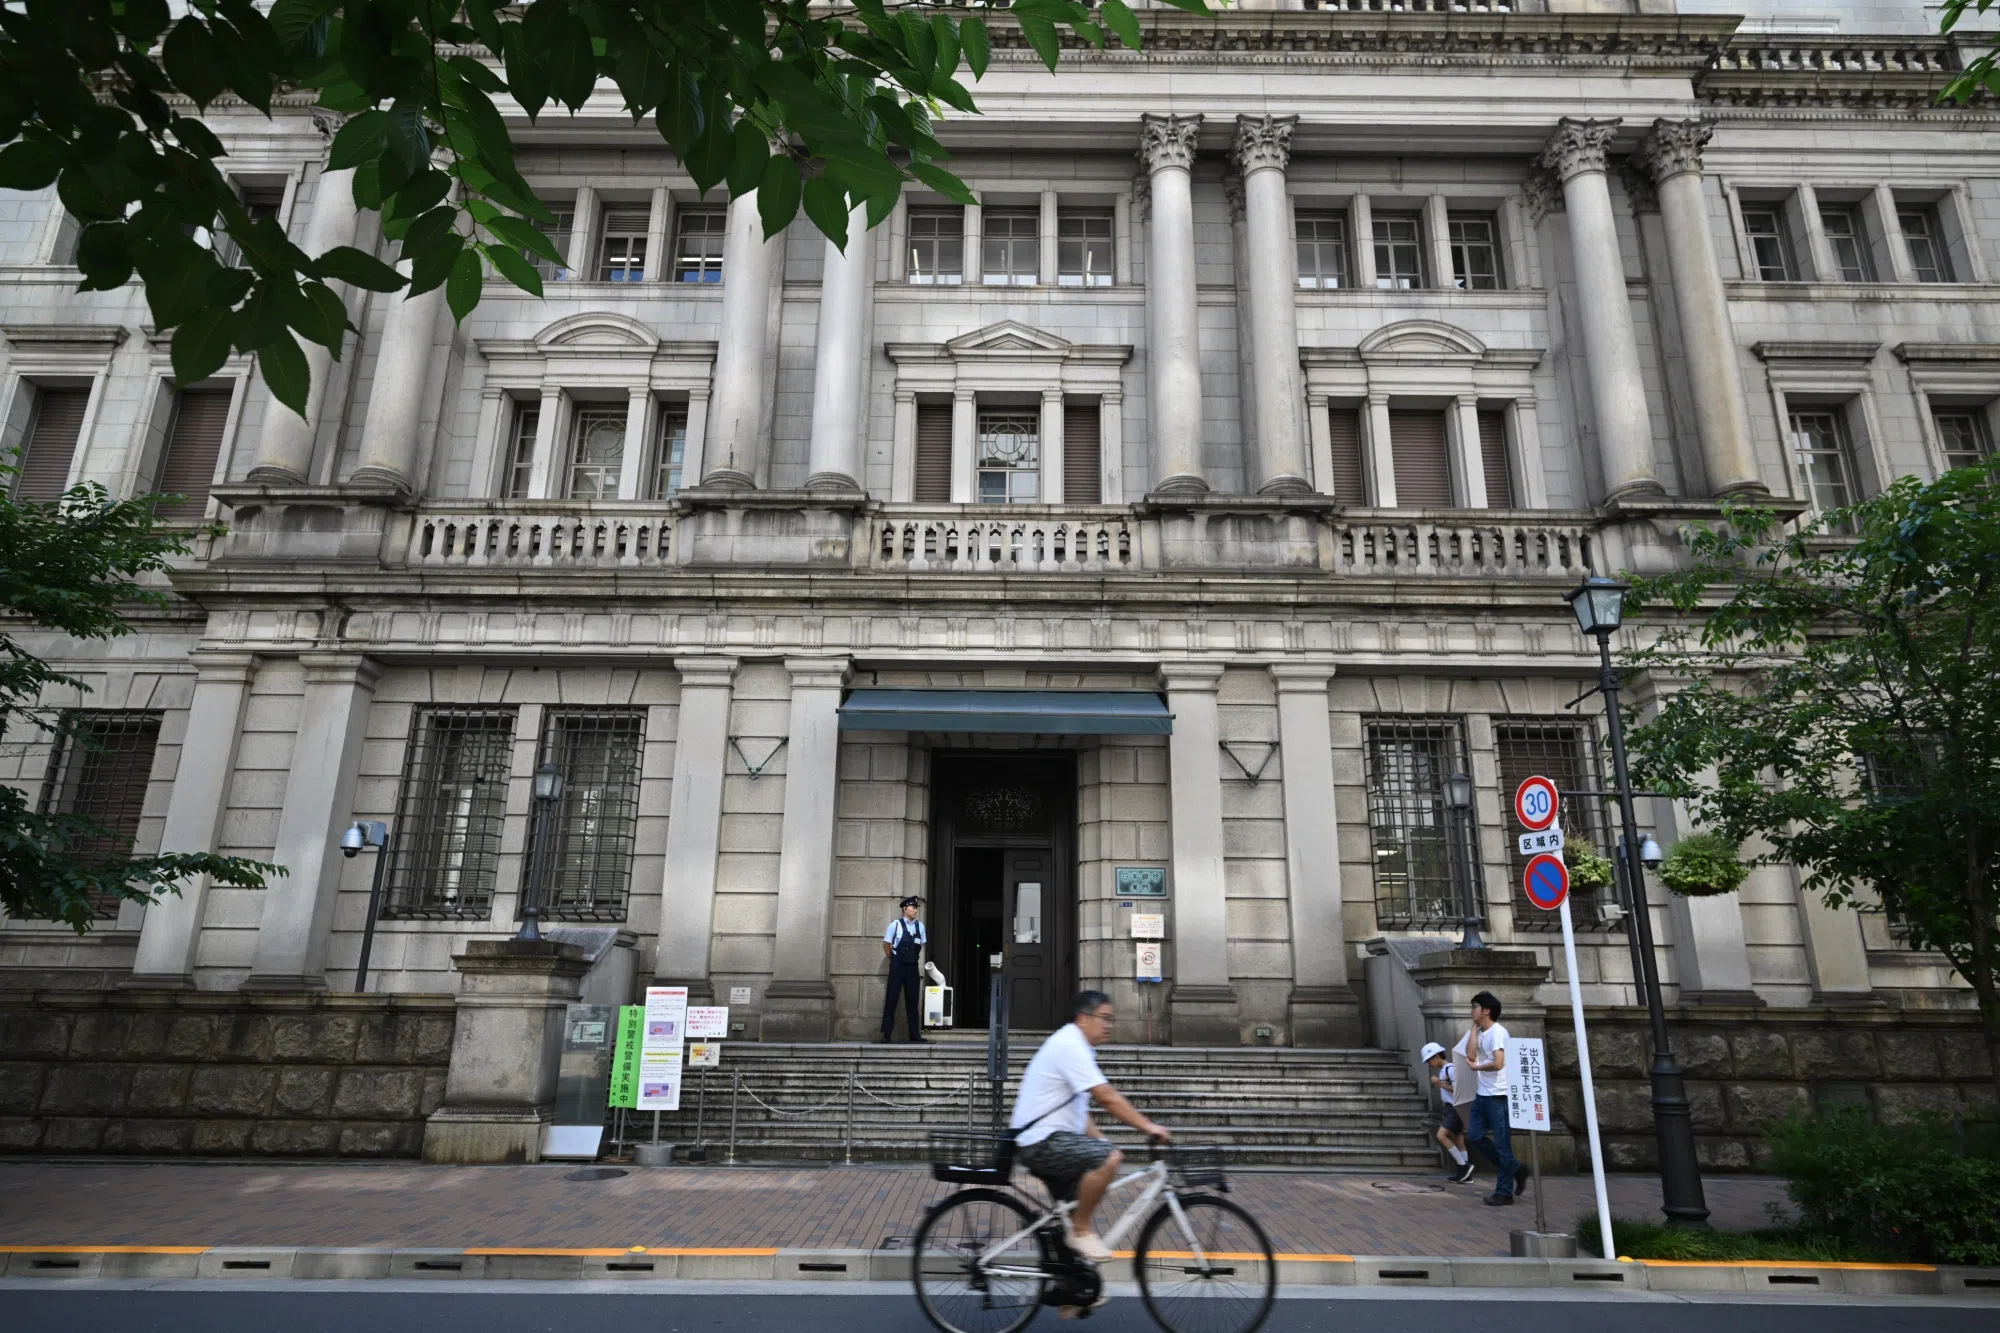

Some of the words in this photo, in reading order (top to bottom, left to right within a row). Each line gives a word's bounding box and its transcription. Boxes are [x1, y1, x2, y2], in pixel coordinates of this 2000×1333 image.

[1525, 791, 1549, 815] 30
[1523, 834, 1559, 850] 区域内
[620, 1009, 638, 1104] 特別警戒警備実施中
[1519, 1047, 1532, 1102] ご遠慮下さい
[1511, 1085, 1519, 1118] 日本銀行
[1530, 1048, 1544, 1122] 出入口につき駐車
